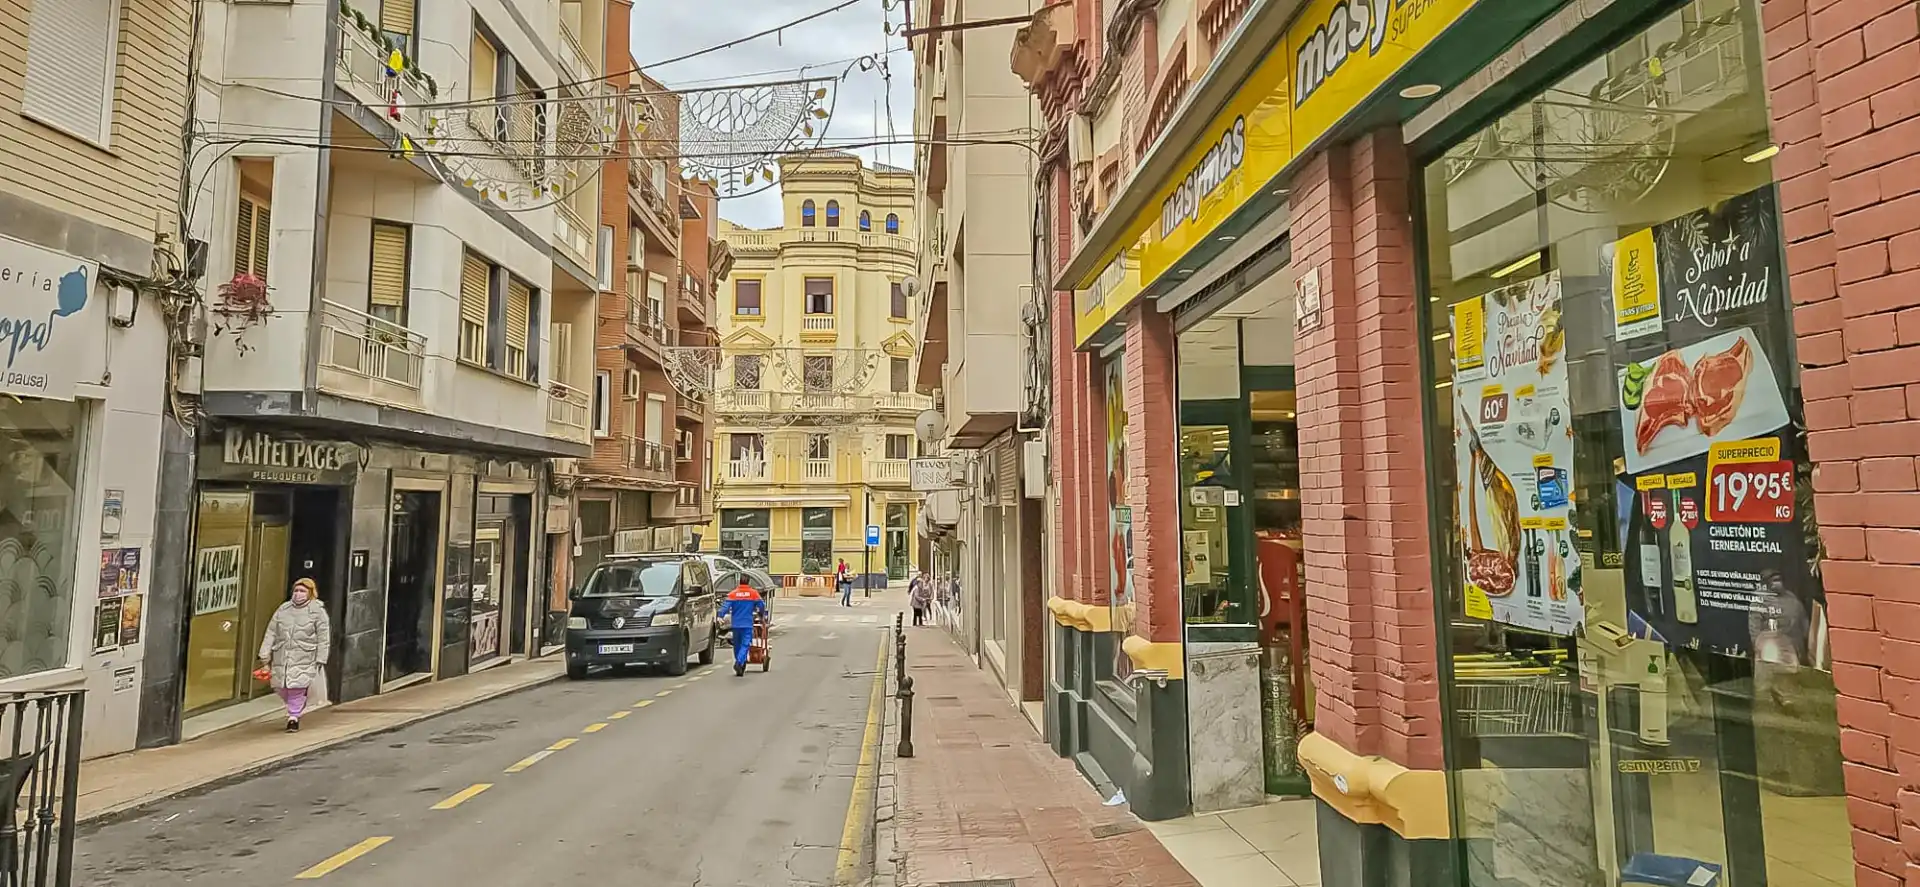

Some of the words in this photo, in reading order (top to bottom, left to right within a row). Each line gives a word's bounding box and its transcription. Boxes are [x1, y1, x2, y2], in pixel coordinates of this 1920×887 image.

[1295, 0, 1400, 111] masy
[1161, 114, 1245, 241] masymas
[1685, 241, 1736, 284] Sabor
[1739, 240, 1750, 262] a
[1675, 266, 1769, 328] Navidad
[1490, 324, 1545, 378] Navidad
[7, 371, 49, 392] pausa)
[1484, 397, 1504, 420] 60€
[1717, 446, 1775, 460] SUPERPRECIO
[1775, 505, 1791, 518] KG
[1709, 524, 1752, 538] CHULETÓN
[1752, 527, 1766, 538] DE
[1709, 540, 1745, 551] TERNERA
[1745, 541, 1783, 553] LECHAL
[200, 547, 240, 583] ALQUILA
